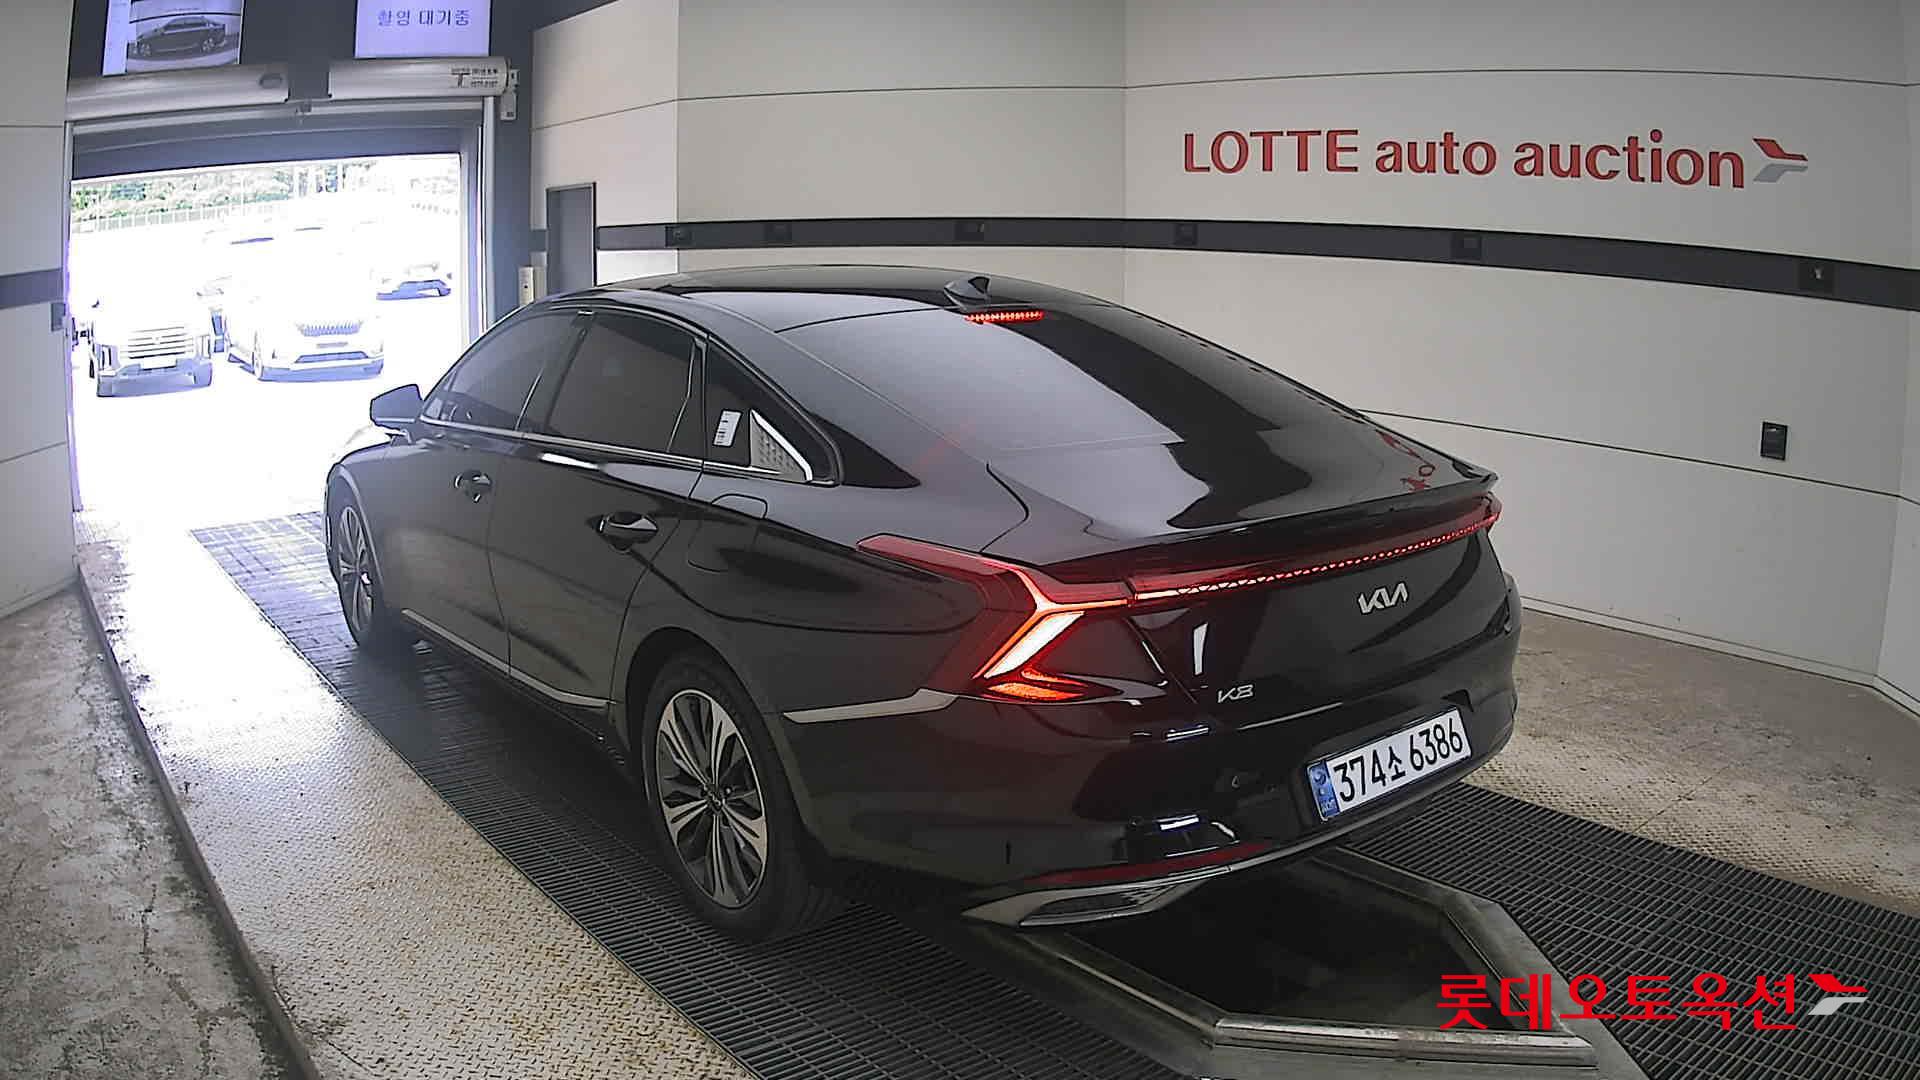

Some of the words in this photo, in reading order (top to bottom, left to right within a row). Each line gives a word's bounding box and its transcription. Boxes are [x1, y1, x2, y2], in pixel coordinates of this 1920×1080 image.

[419, 9, 470, 26] 대기중
[1184, 130, 1359, 173] LOTTE
[1375, 132, 1498, 176] auto
[1513, 130, 1746, 188] auction
[1357, 583, 1408, 614] KIA
[1217, 684, 1253, 703] K8
[1333, 747, 1406, 803] 374소
[1409, 718, 1463, 771] 6386
